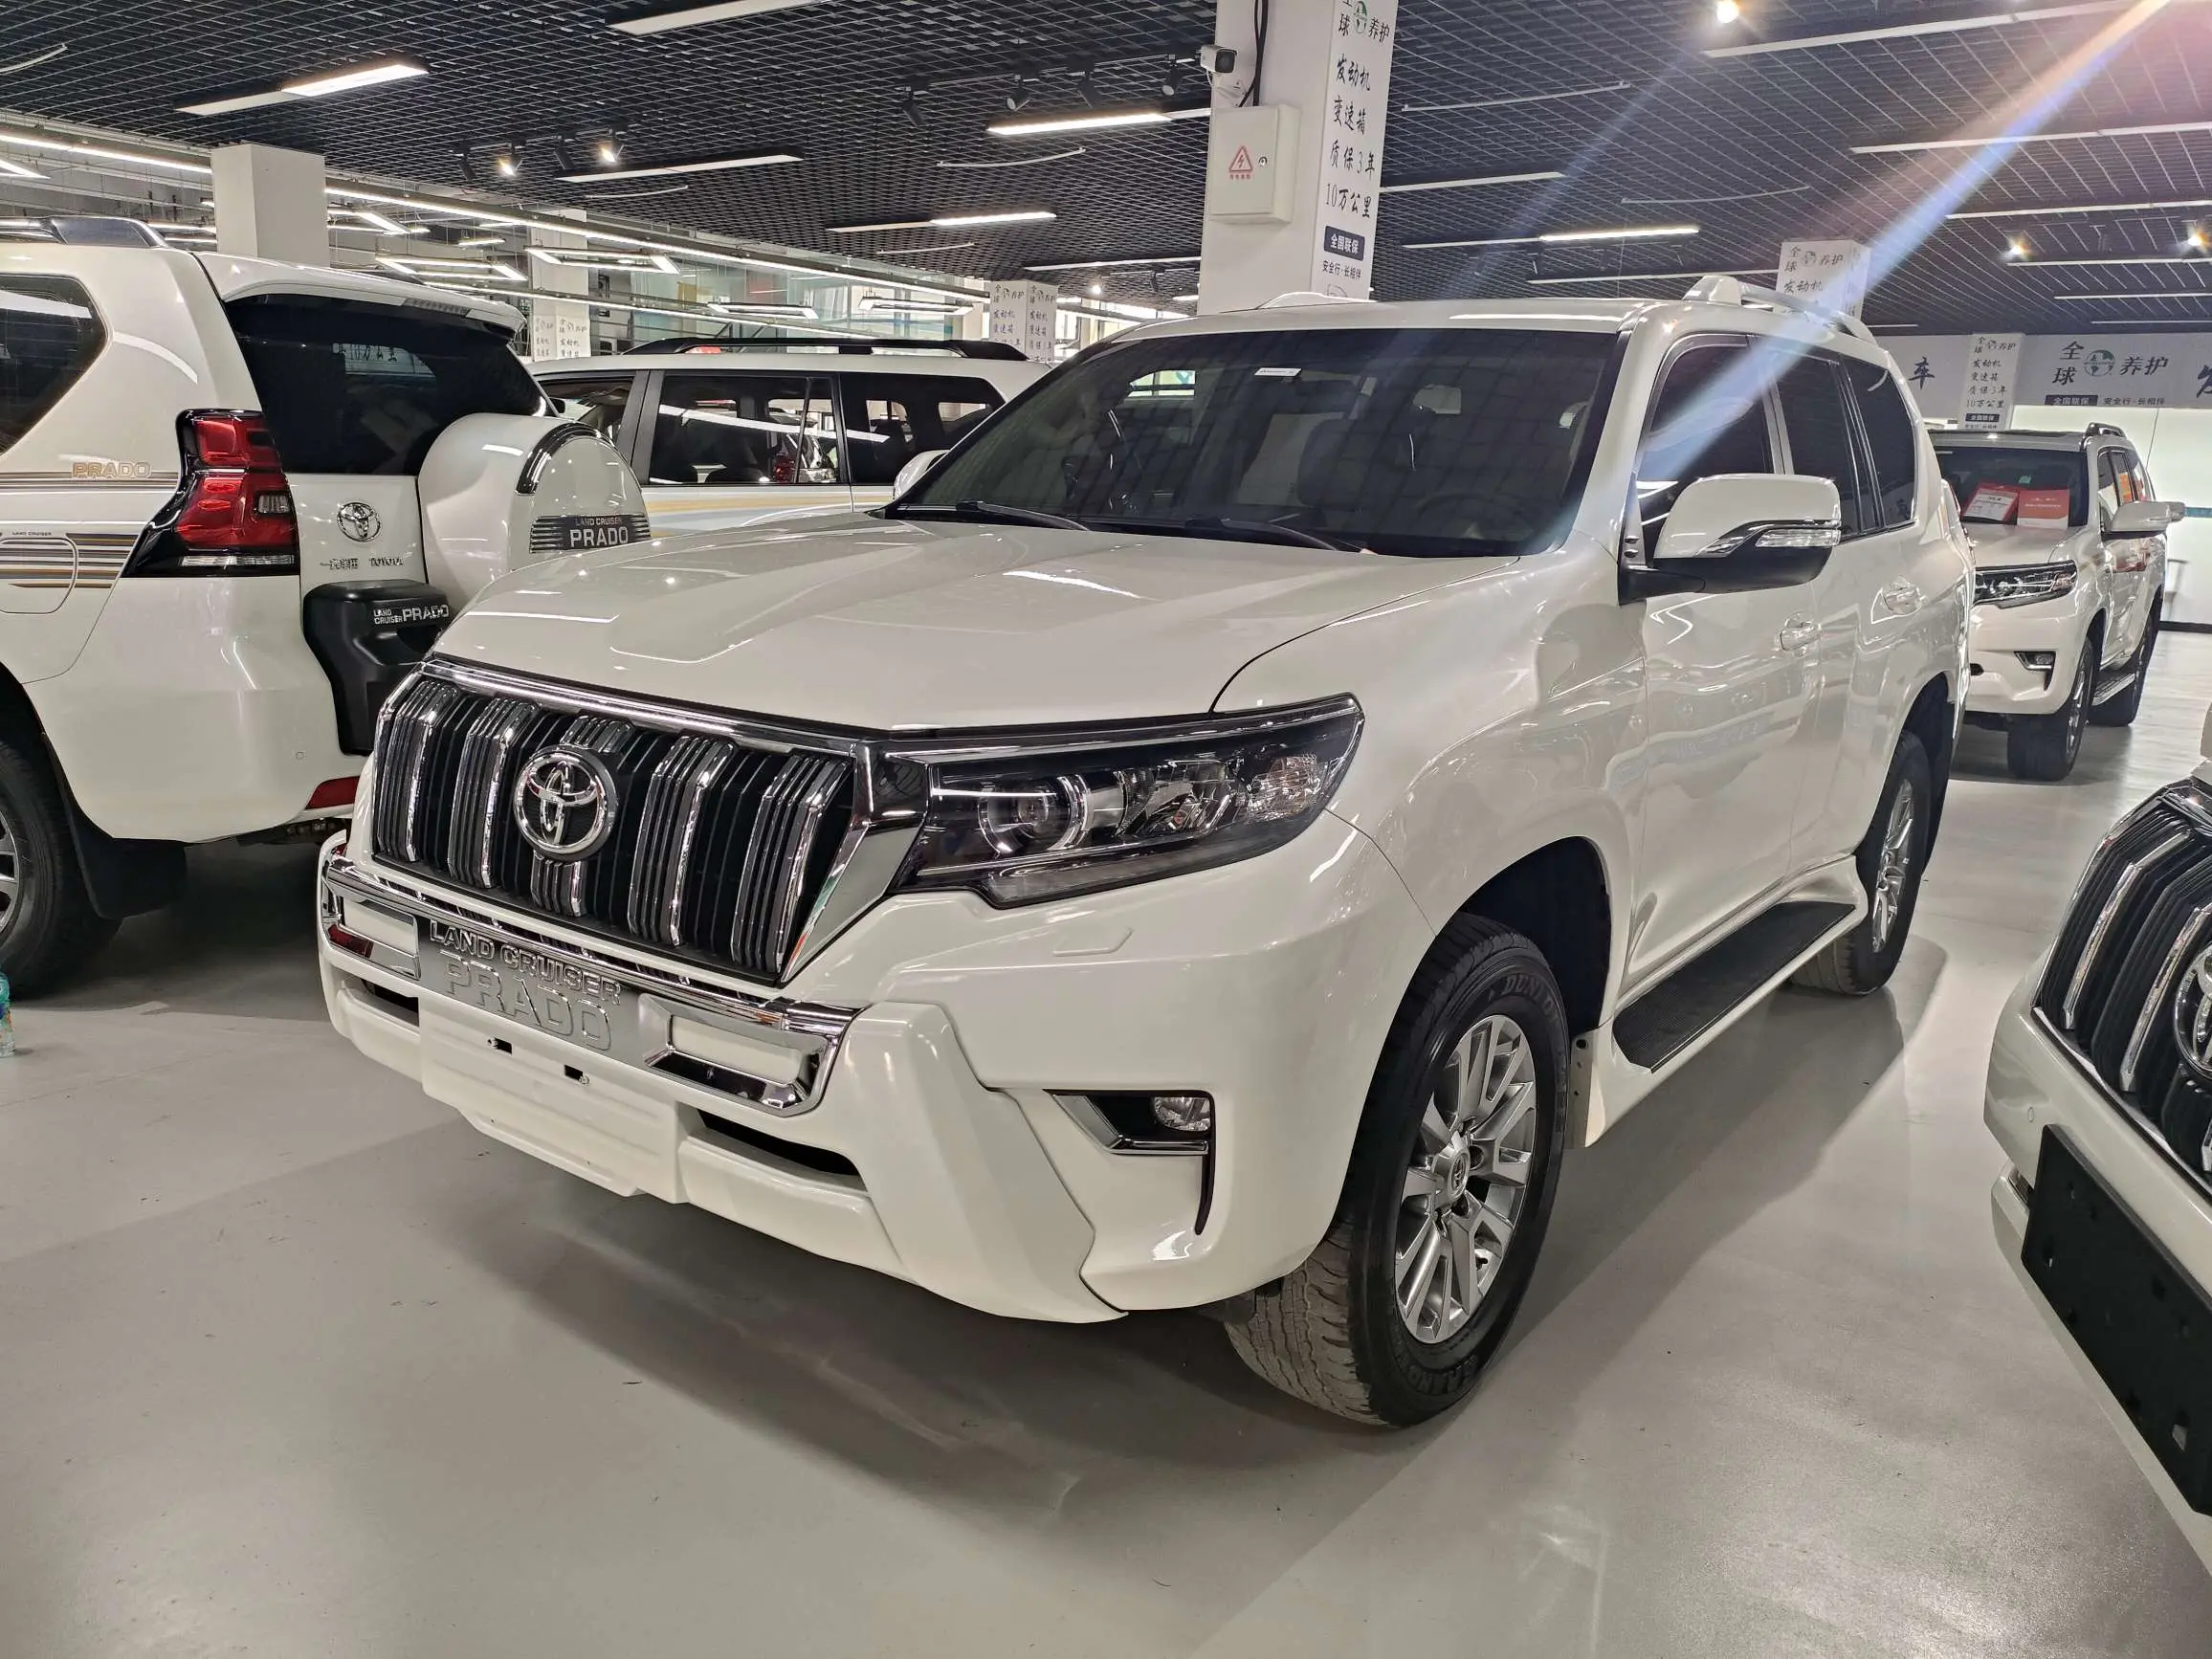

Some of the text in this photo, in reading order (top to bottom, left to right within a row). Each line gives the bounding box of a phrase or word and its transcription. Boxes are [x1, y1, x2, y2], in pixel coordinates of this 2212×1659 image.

[1368, 17, 1390, 42] 养护
[1336, 54, 1370, 91] 发动机
[1333, 96, 1366, 135] 变速箱
[1330, 139, 1376, 181] 质保3年
[1326, 184, 1372, 218] 10万公里
[1908, 356, 1936, 391] 车
[2052, 341, 2170, 387] 全球 养护
[72, 461, 151, 478] PRADO
[569, 526, 629, 547] PRADO
[575, 517, 623, 527] LAND CRUISER
[373, 608, 392, 618] LAND
[373, 615, 403, 625] CRUISER
[402, 604, 450, 622] PRADO
[431, 919, 621, 1006] LAND CRUISER
[439, 949, 612, 1051] PRADO
